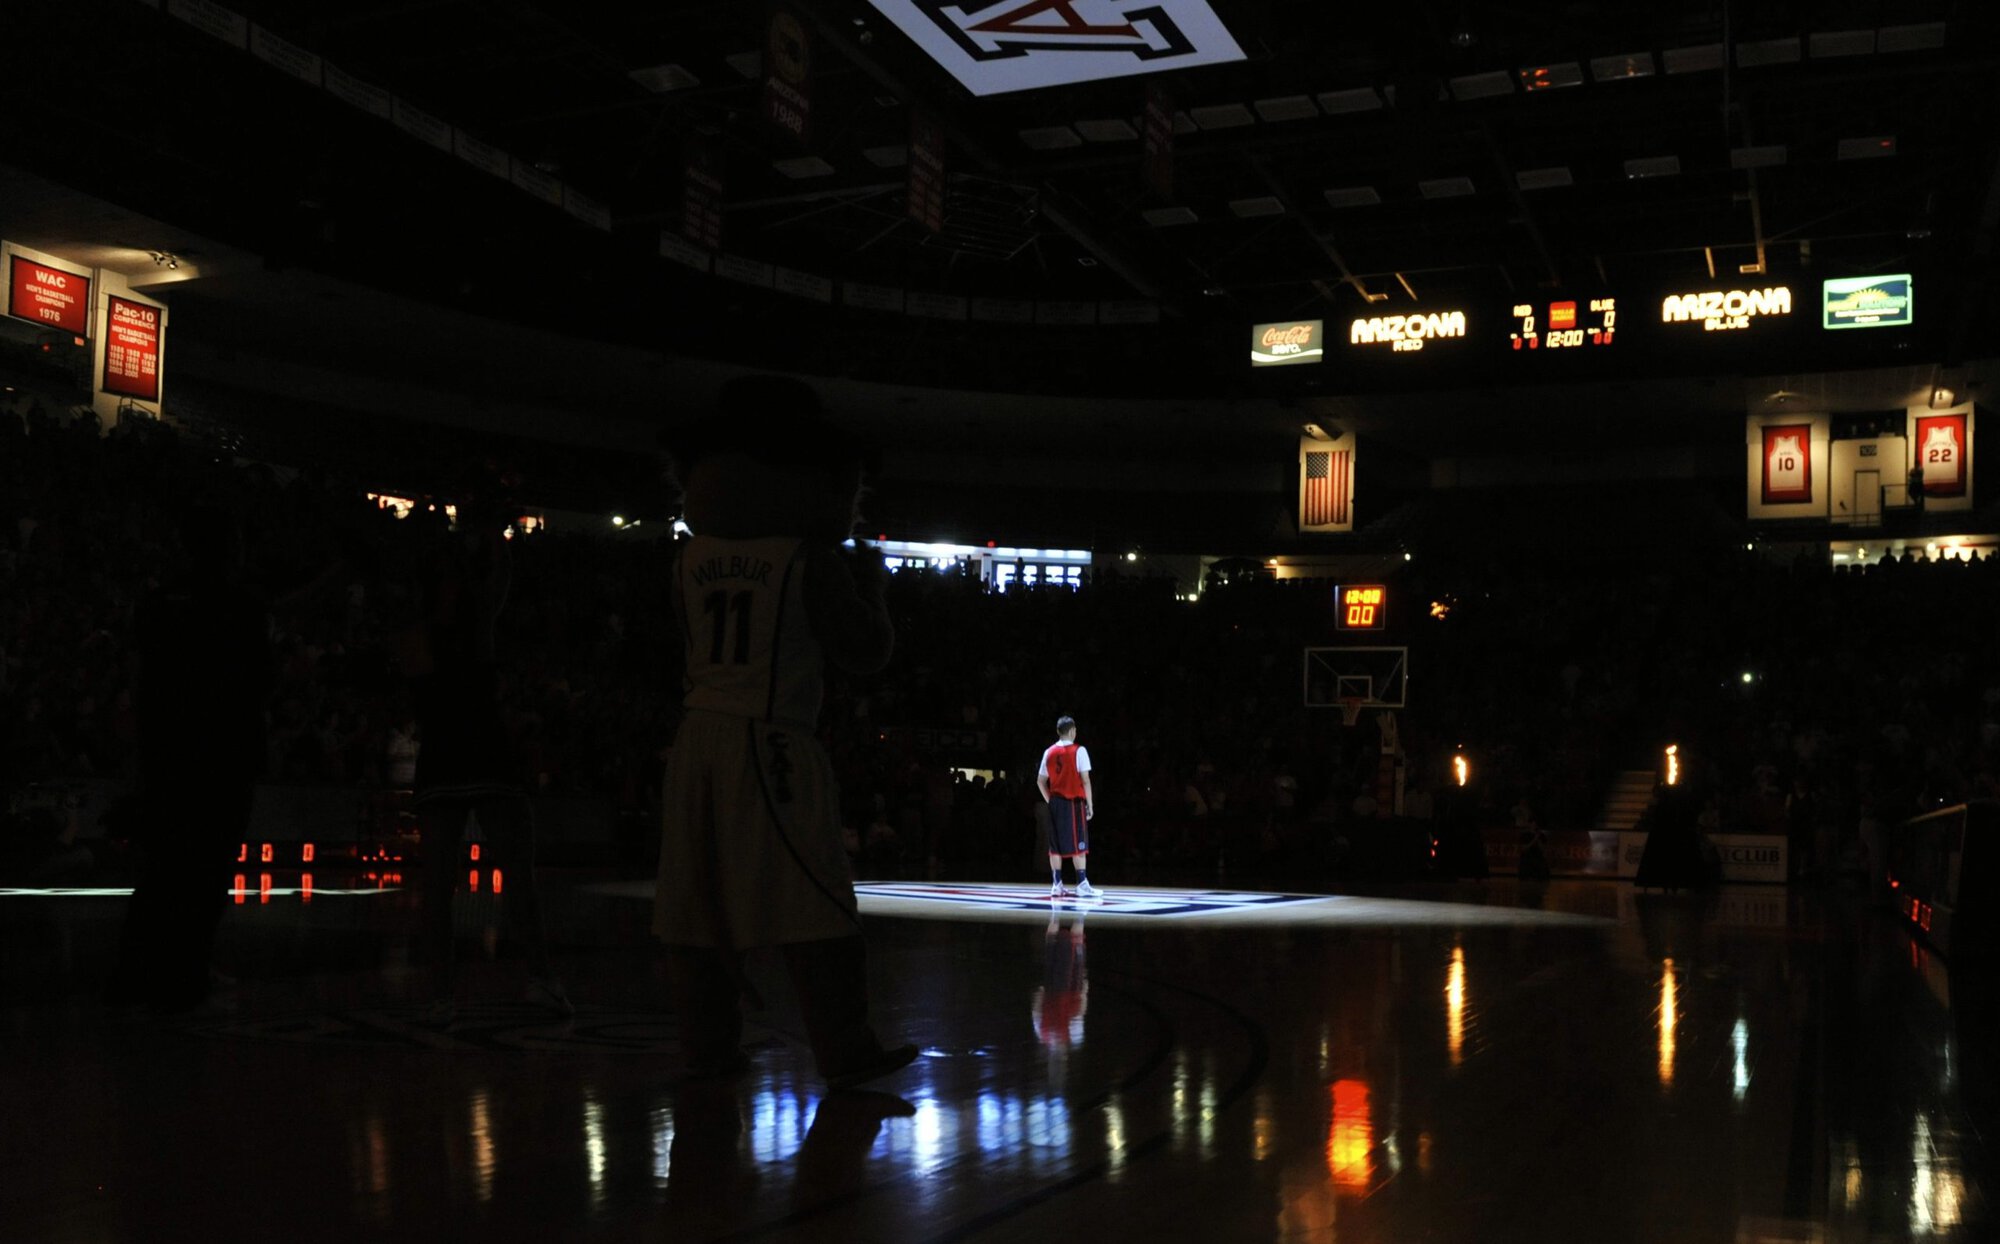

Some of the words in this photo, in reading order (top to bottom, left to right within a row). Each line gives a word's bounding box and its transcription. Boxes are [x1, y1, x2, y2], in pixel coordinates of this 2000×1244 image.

[35, 270, 66, 289] WAC
[115, 303, 154, 322] Pac-10
[1663, 287, 1791, 322] ARIZONA
[39, 307, 61, 322] 1976
[1604, 311, 1616, 328] 0
[1705, 315, 1749, 331] BLUE
[1351, 311, 1466, 344] ARIZONA
[1523, 316, 1535, 333] 0
[1393, 339, 1423, 352] RED
[1546, 329, 1584, 348] 12:00
[1778, 457, 1795, 471] 10
[1929, 449, 1952, 463] 22
[690, 555, 773, 585] WILBUR
[1346, 589, 1381, 605] 12:00
[1347, 605, 1374, 625] 00
[704, 589, 754, 664] 11
[1732, 848, 1780, 863] CLUB
